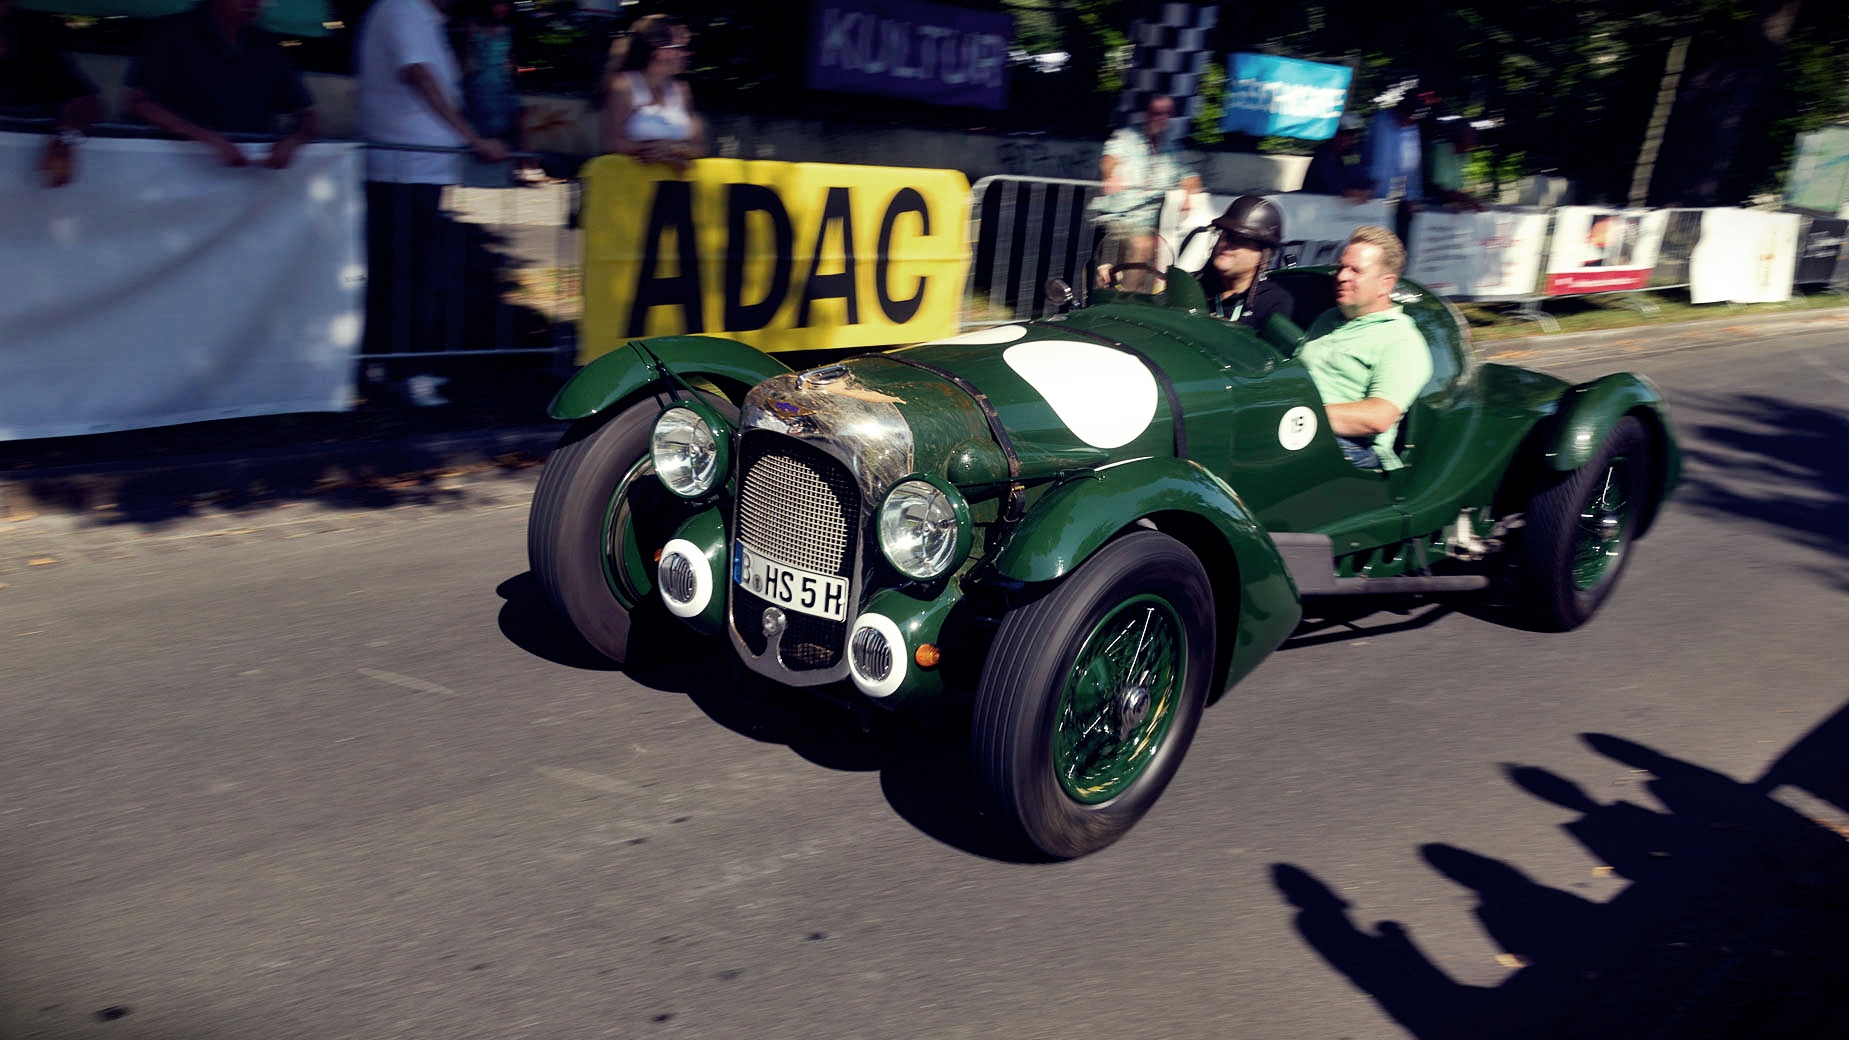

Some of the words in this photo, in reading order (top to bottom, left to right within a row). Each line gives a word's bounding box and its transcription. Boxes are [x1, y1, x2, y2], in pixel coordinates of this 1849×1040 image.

[820, 8, 1004, 88] KULTUR
[624, 180, 931, 338] ADAC
[765, 564, 794, 603] HS
